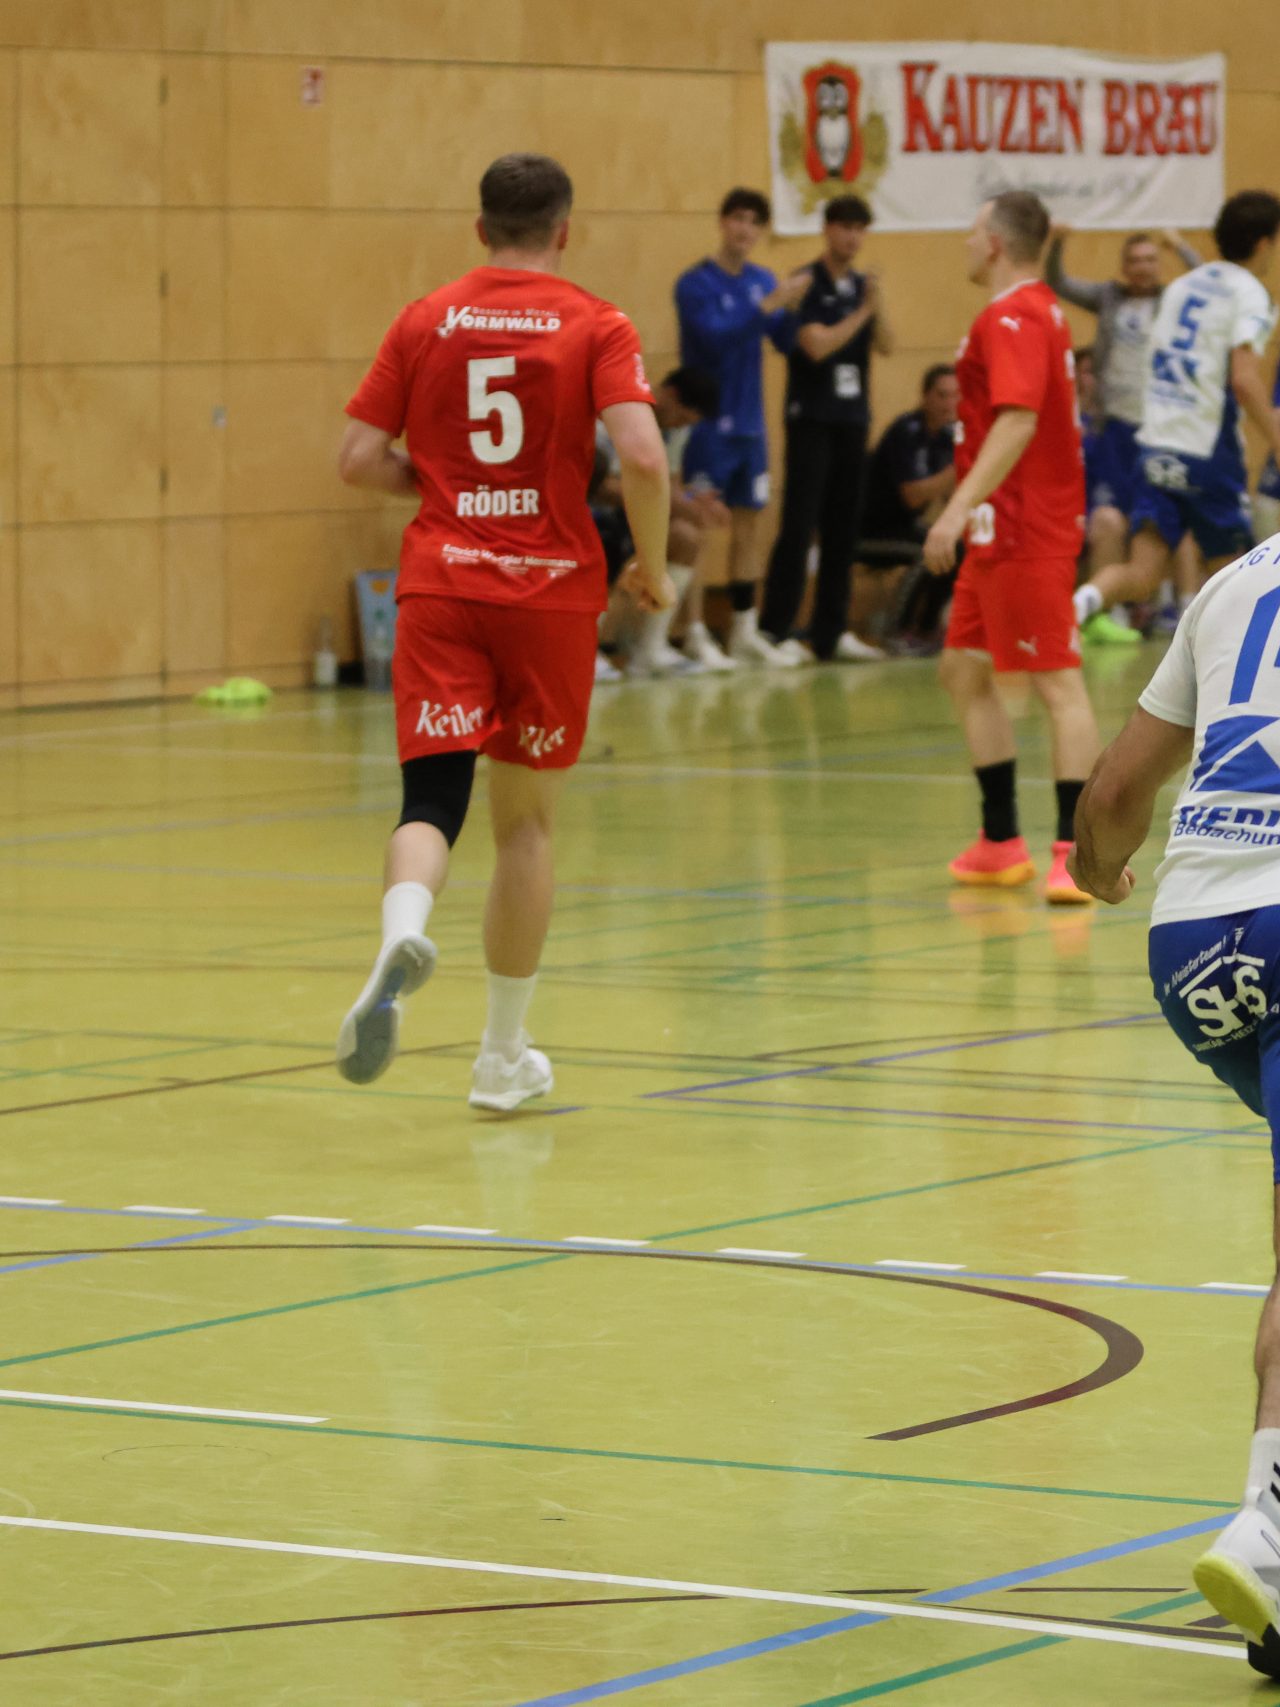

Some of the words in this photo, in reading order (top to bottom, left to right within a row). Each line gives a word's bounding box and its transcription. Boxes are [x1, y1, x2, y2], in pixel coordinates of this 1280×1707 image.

[901, 62, 1084, 154] KAUZEN
[1171, 293, 1207, 350] 5
[467, 356, 524, 465] 5
[457, 485, 540, 517] RÖDER
[415, 700, 484, 738] Keiler
